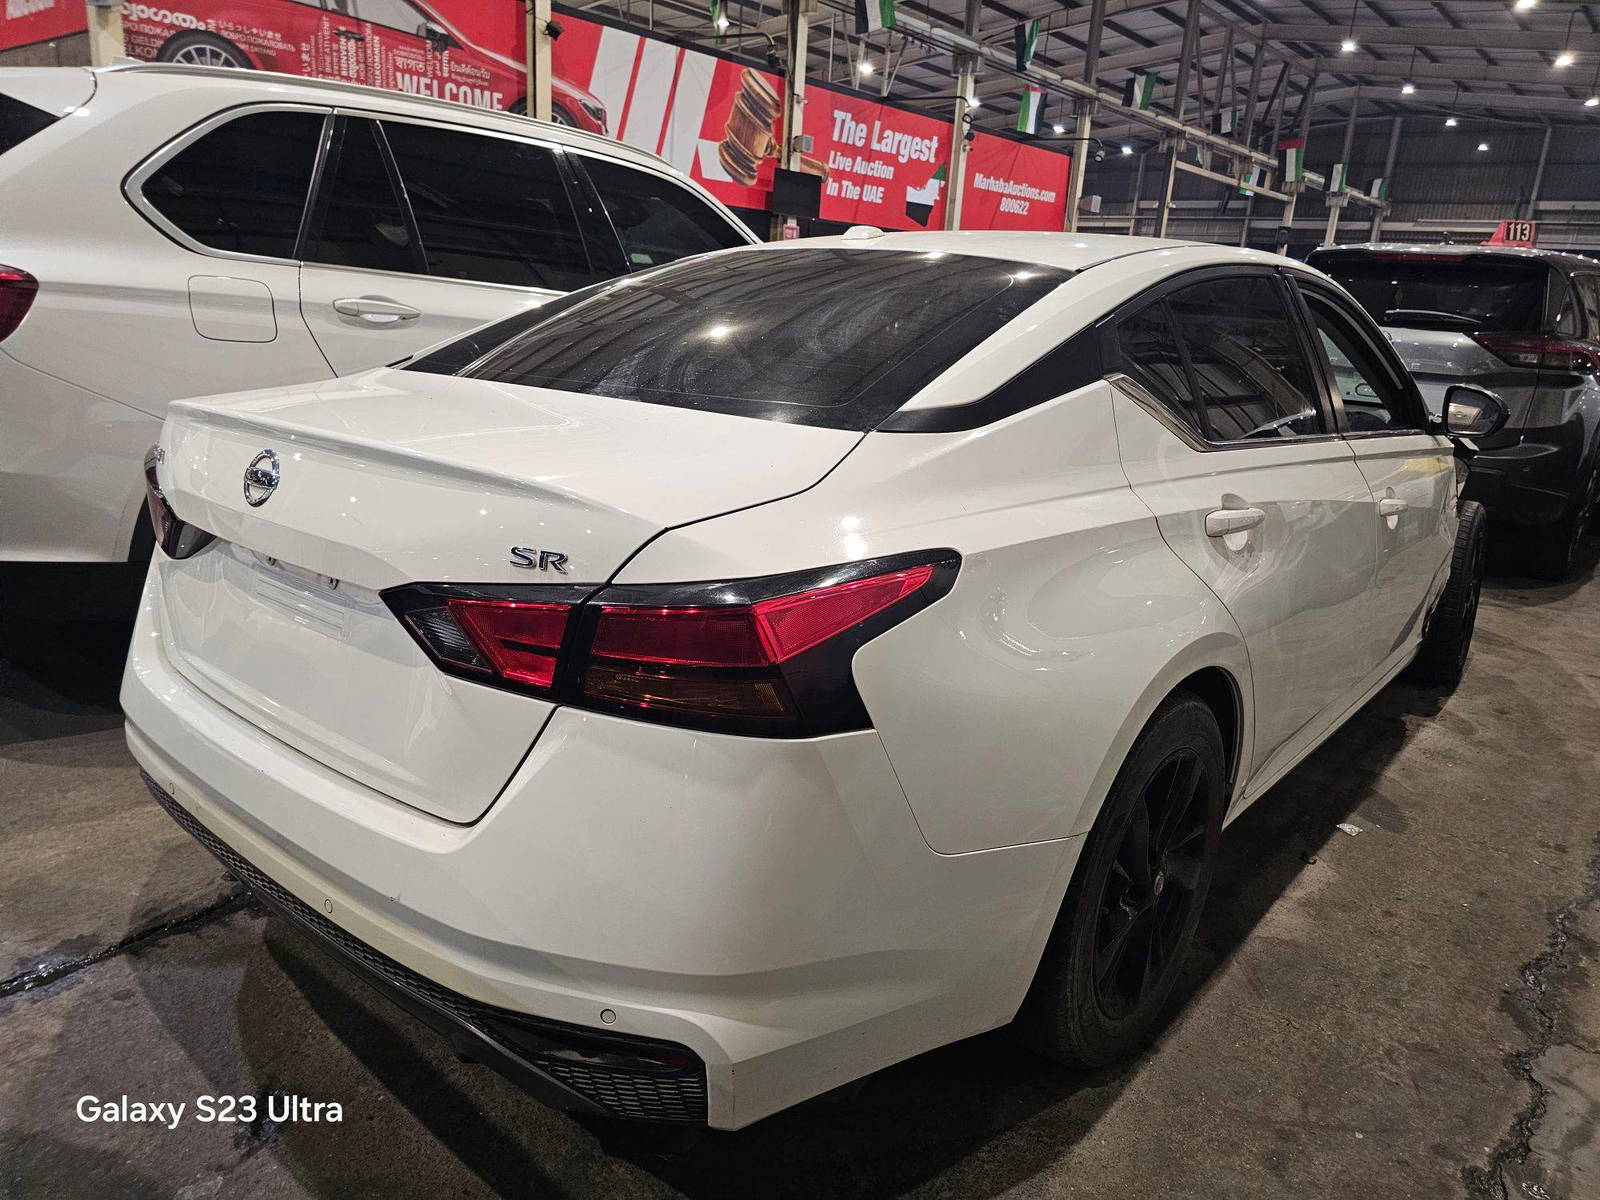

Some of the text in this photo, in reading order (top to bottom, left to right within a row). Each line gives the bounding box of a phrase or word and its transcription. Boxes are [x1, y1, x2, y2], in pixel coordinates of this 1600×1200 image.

[396, 71, 503, 111] WELCOME
[832, 109, 939, 164] The Largest
[828, 150, 895, 180] Live Auction
[826, 178, 885, 204] In The UAE
[973, 172, 1056, 203] MarhabaAuctions.com
[1000, 197, 1030, 216] 800622
[1509, 223, 1531, 241] 113
[509, 546, 569, 576] SR
